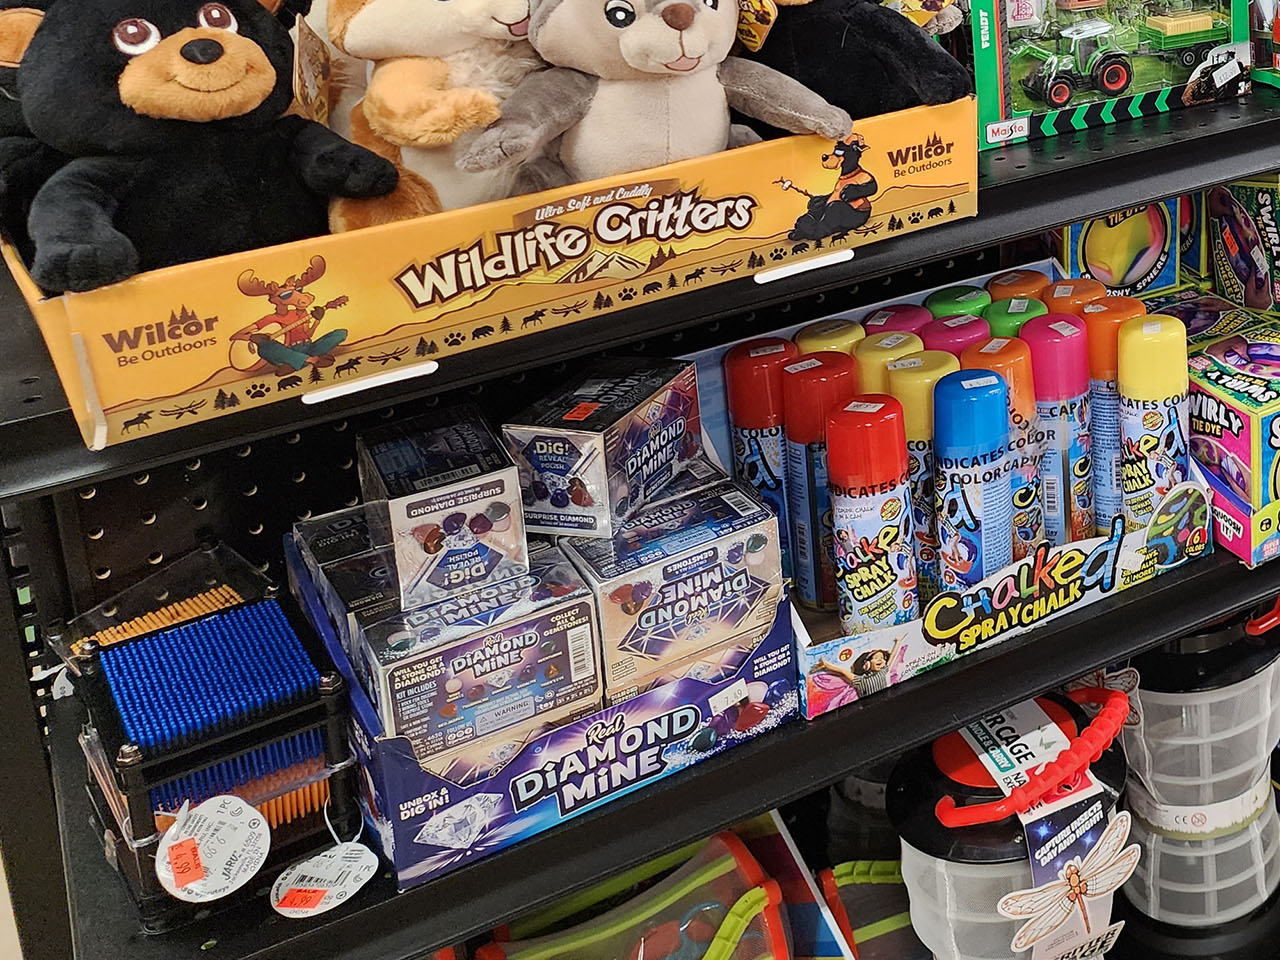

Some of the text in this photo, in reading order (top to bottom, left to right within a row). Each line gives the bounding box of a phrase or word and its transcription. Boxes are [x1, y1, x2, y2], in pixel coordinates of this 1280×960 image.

[979, 9, 990, 49] FENDT
[990, 124, 1025, 140] Maisto
[887, 141, 954, 168] Wilcor
[894, 158, 952, 178] Be Outdoors
[535, 184, 653, 222] Ultra Soft and Cuddly
[400, 195, 754, 308] Wildlife Critters
[102, 316, 218, 354] Wilcor
[117, 337, 217, 367] Be Outdoors
[1192, 418, 1222, 436] TIE DYE
[1007, 430, 1056, 452] COLOR
[1123, 475, 1154, 493] CHALK
[525, 512, 595, 523] SURPRISE DIAMOND
[1193, 531, 1200, 544] 6
[1221, 525, 1232, 540] IT!
[1185, 544, 1205, 554] COLORS
[845, 556, 890, 589] SPRAY
[853, 570, 897, 601] CHALK
[1133, 567, 1155, 583] MORE!
[551, 608, 580, 623] COLLECT
[958, 580, 1082, 652] SPRAY CHALK
[754, 658, 792, 679] DIAMOND?
[407, 680, 437, 695] INCLUDES
[586, 716, 625, 746] Real
[996, 724, 1035, 765] CAGE
[399, 791, 438, 812] UNBOX
[399, 795, 450, 821] DIG IN!
[1034, 801, 1102, 860] CAPTURE INSECTS
[1040, 812, 1104, 867] DAY AND NIGHT!
[220, 852, 237, 880] JARU
